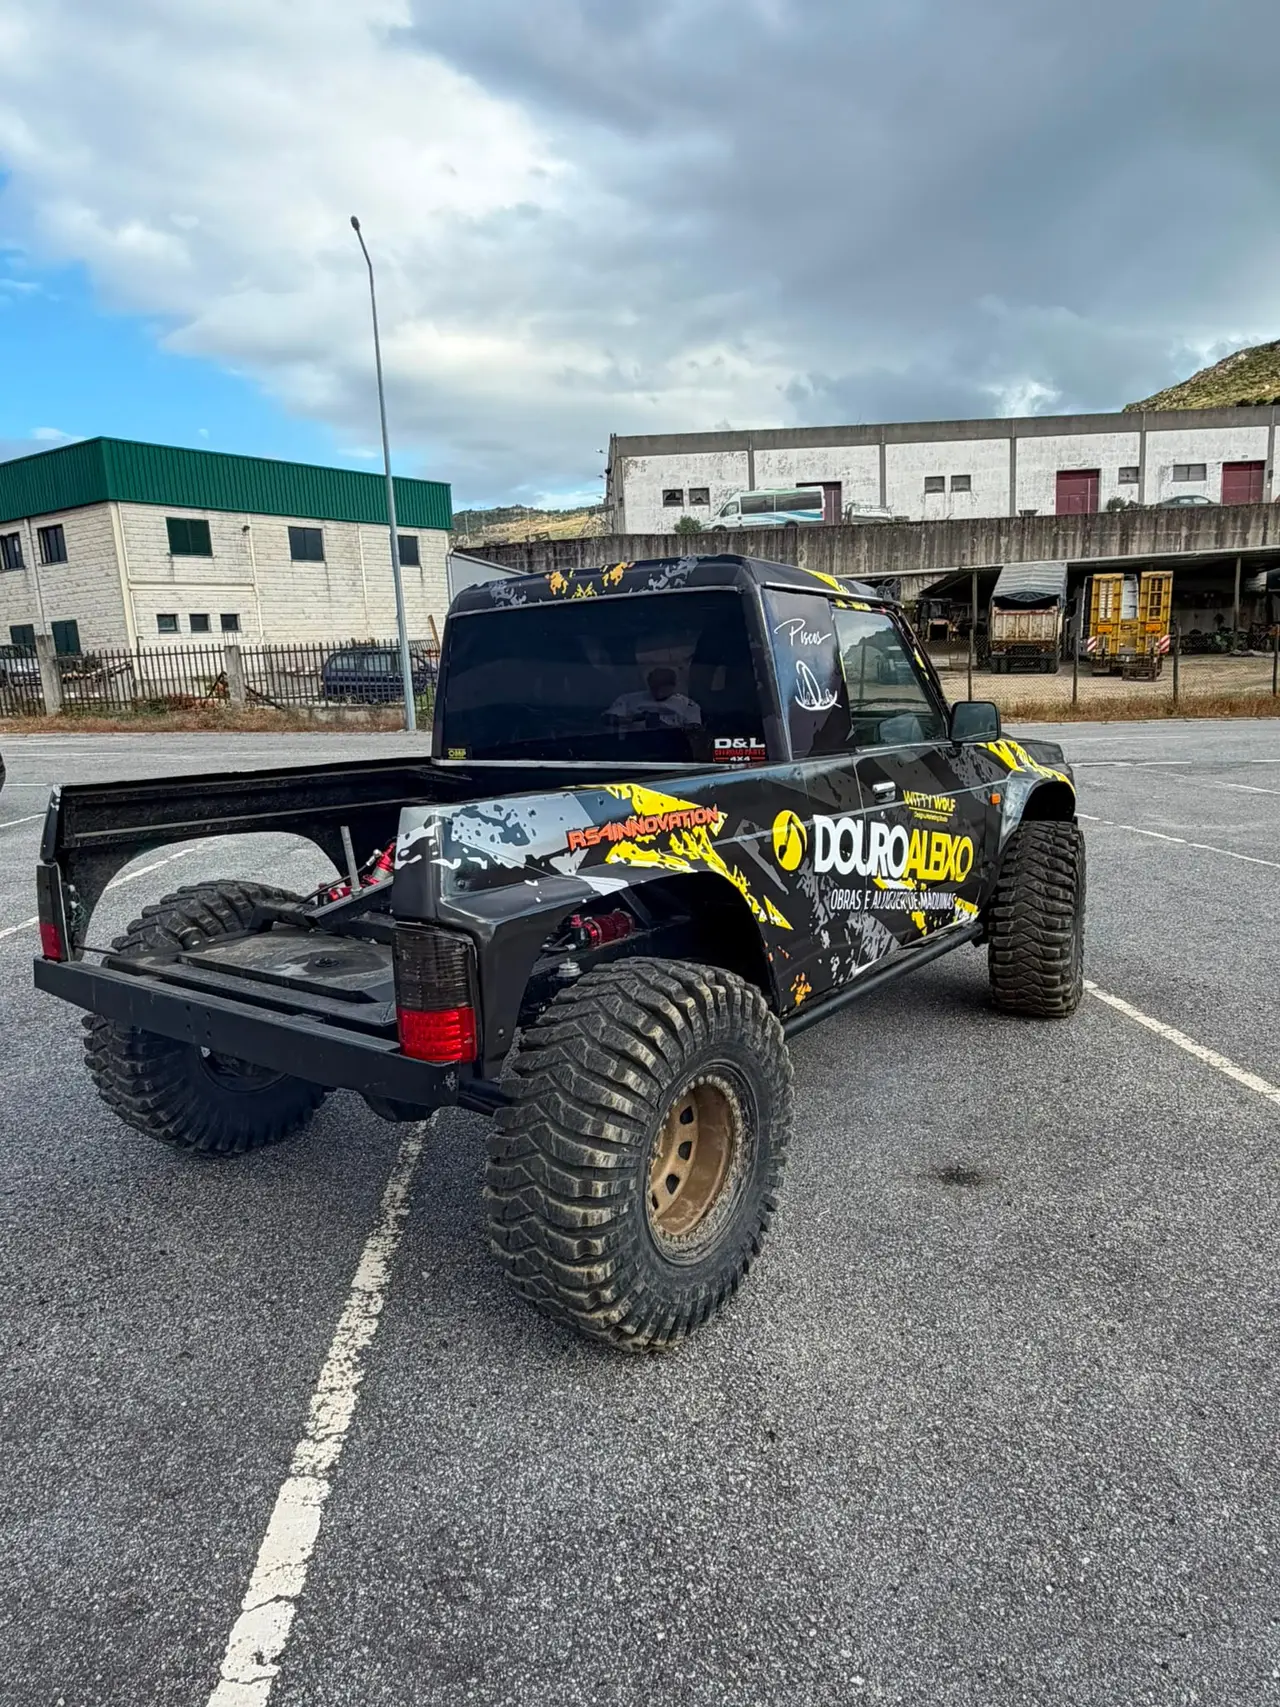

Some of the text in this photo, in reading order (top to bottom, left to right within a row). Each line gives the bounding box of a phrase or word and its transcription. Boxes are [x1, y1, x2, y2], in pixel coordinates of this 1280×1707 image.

[714, 737, 766, 749] D&L
[903, 790, 956, 812] WITTY WOLF
[567, 803, 719, 852] RS4INNOVATION
[830, 889, 862, 910] OBRAS
[864, 890, 872, 910] E
[871, 890, 907, 910] ALUGUER
[908, 891, 919, 910] DE
